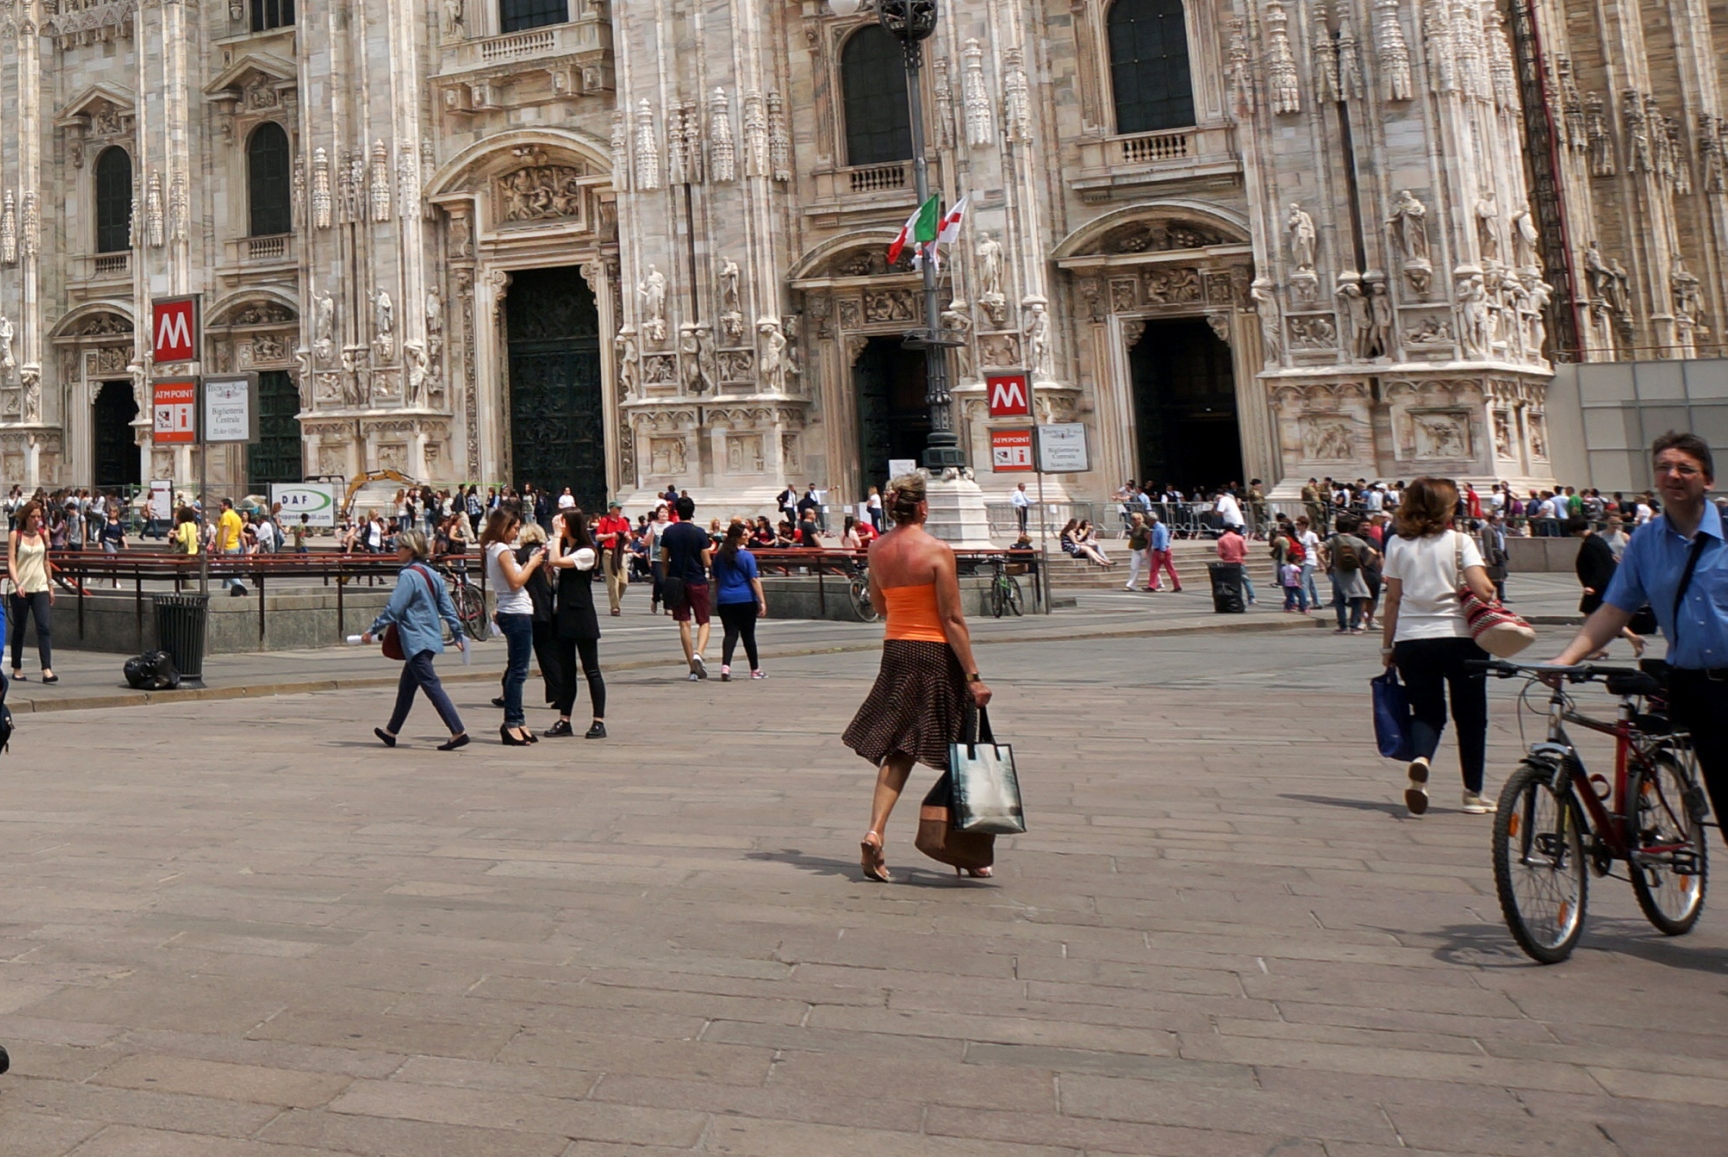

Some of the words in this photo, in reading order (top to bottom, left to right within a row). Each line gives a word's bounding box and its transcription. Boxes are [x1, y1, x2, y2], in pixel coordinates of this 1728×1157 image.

[157, 311, 192, 350] M
[171, 389, 193, 398] POINT
[991, 382, 1026, 409] M
